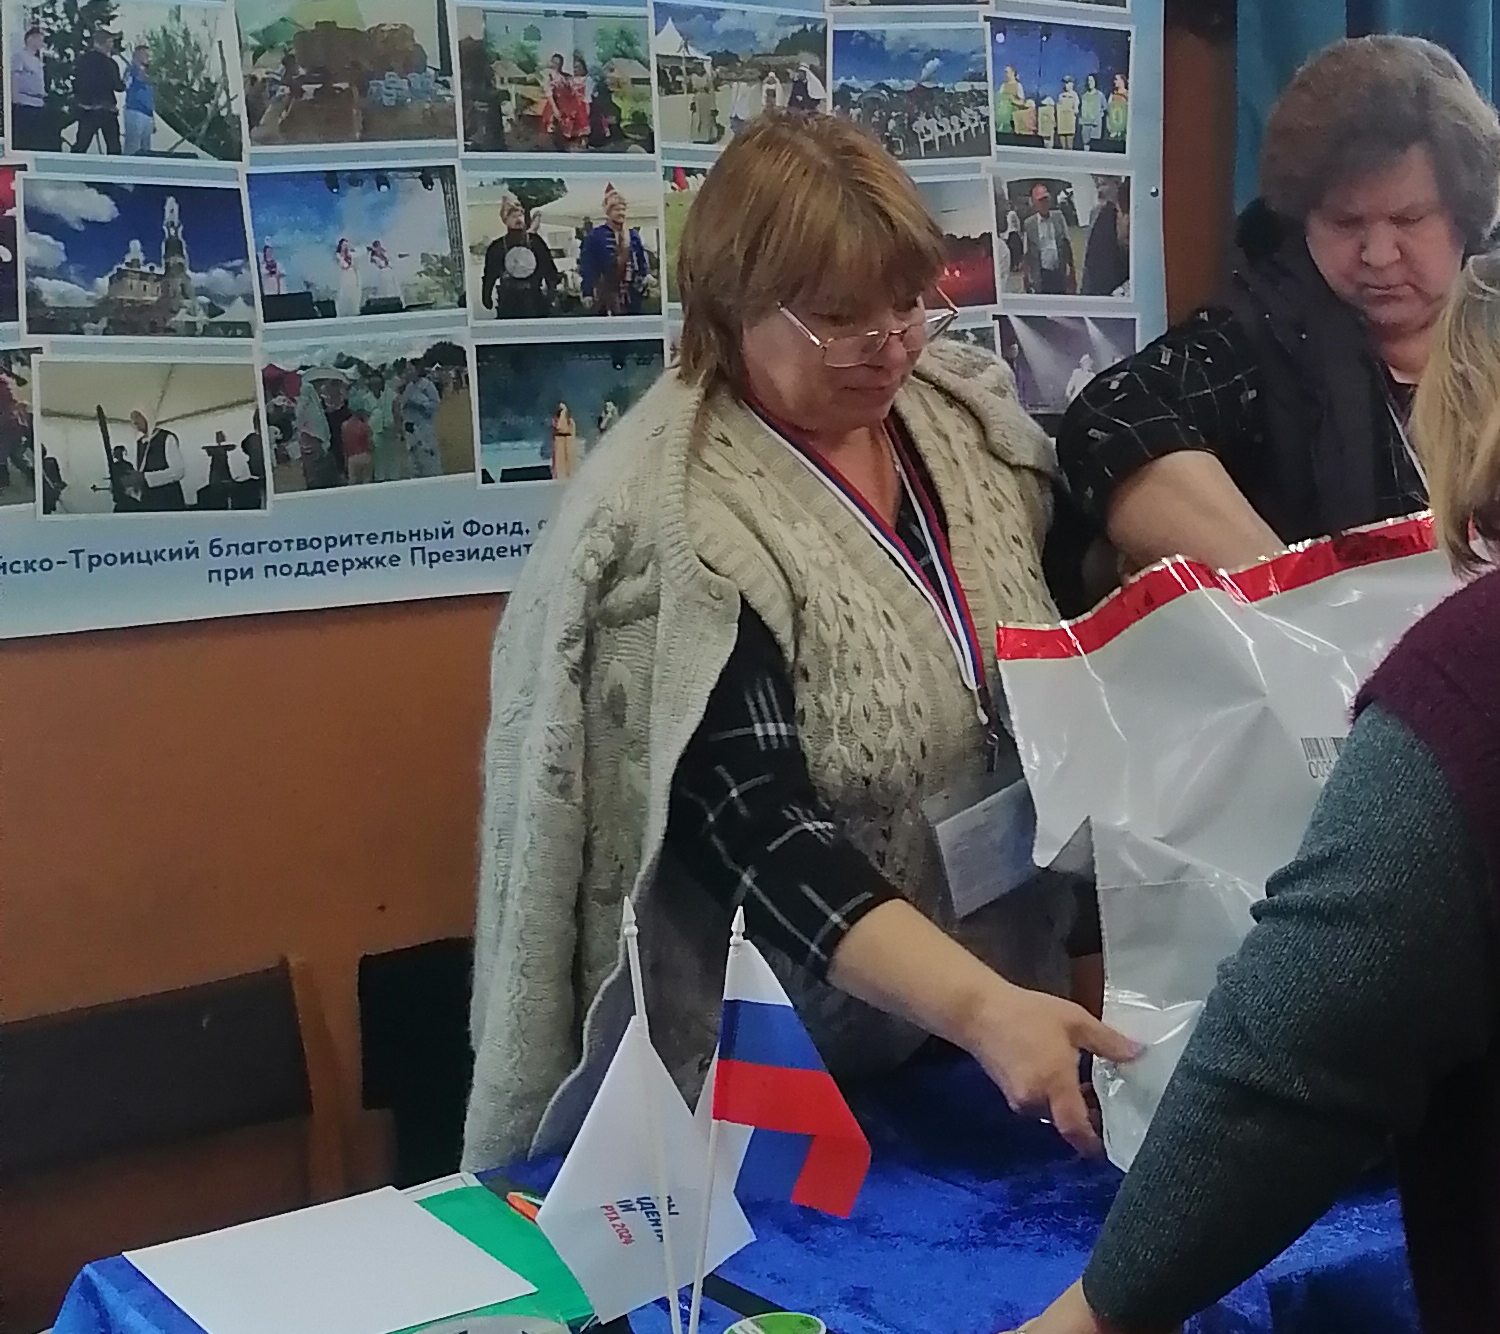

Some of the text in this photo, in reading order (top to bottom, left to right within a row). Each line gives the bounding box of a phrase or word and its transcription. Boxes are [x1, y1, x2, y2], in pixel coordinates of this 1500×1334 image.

[207, 518, 454, 559] благотворительный
[207, 541, 533, 587] при поддержке Президент
